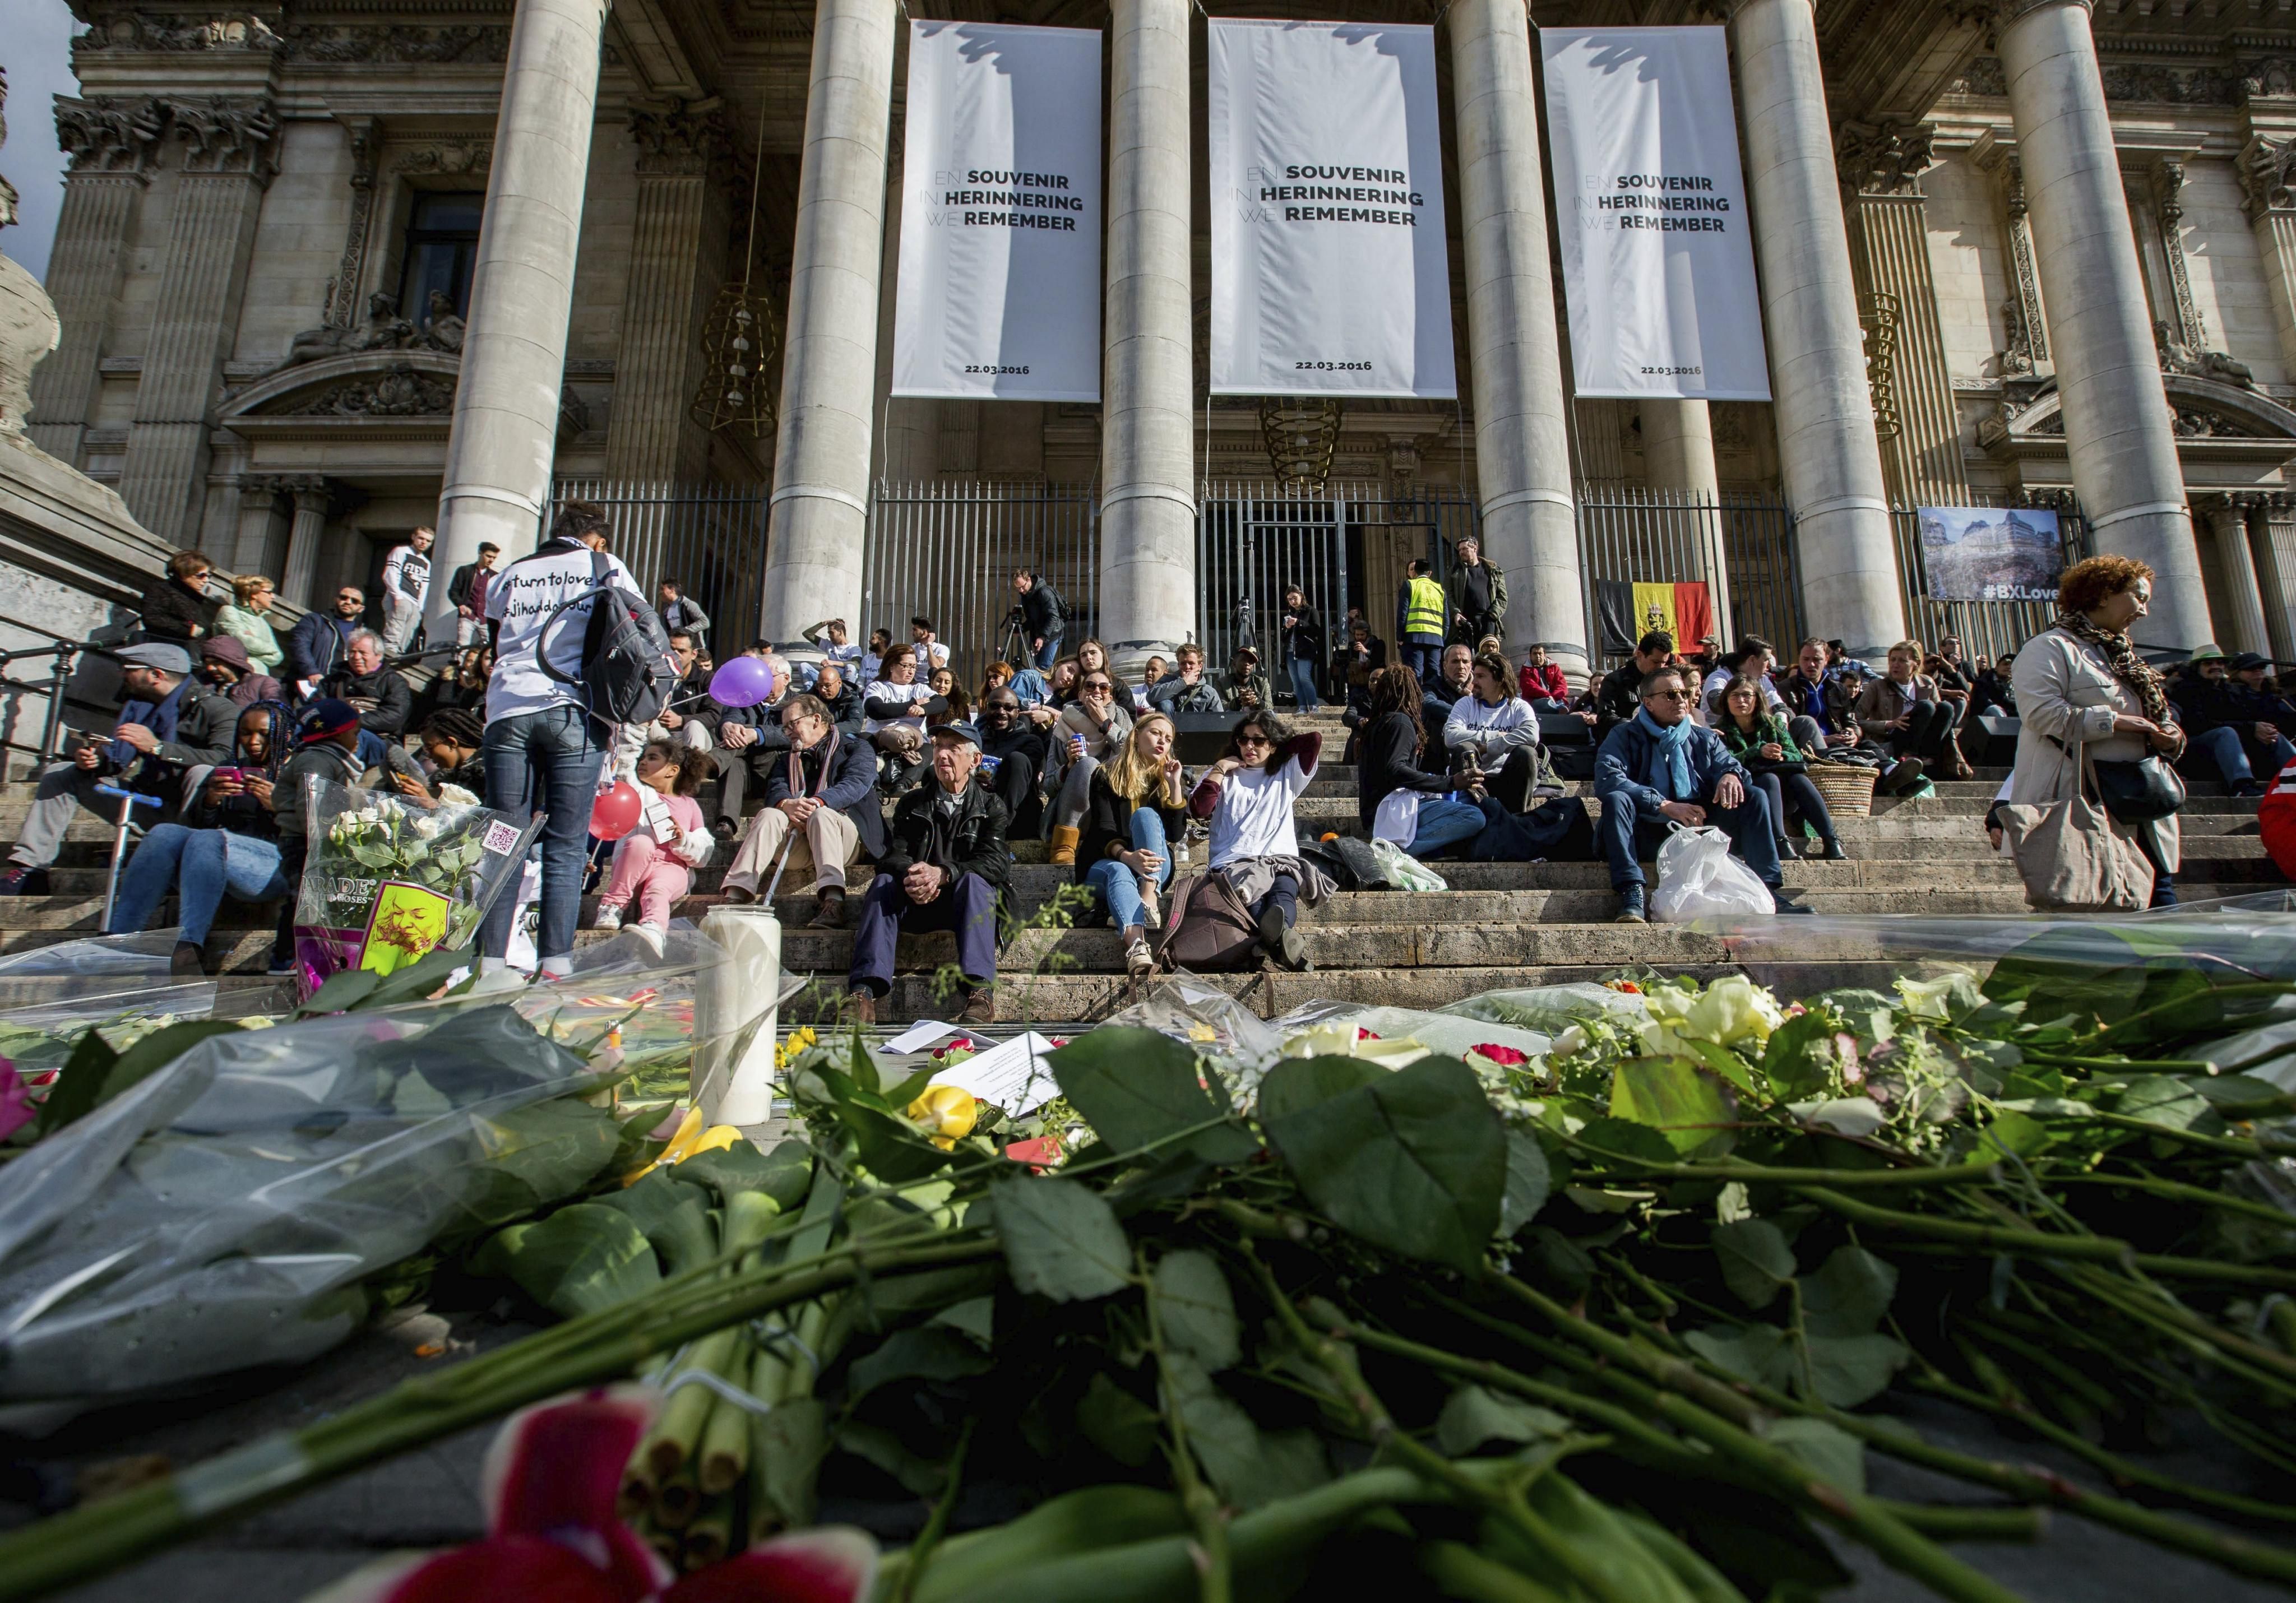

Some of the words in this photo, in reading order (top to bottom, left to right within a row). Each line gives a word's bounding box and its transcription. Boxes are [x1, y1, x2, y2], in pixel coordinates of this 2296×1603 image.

[935, 171, 960, 184] EN
[968, 170, 1069, 189] SOUVENIR
[1248, 166, 1277, 181] EN
[1286, 166, 1406, 184] SOUVENIR
[1586, 175, 1610, 189] EN
[1618, 175, 1713, 191] SOUVENIR
[920, 189, 938, 205] IN
[945, 191, 1082, 211] HERINNERING
[1232, 188, 1251, 202] IN
[1261, 186, 1424, 206] HERINNERING
[1574, 196, 1592, 210] IN
[1598, 195, 1730, 211] HERINNERING
[925, 212, 958, 226] WE
[964, 212, 1076, 231] REMEMBER
[1238, 208, 1276, 223] WE
[1285, 207, 1417, 226] REMEMBER
[1582, 216, 1614, 230] WE
[1620, 215, 1725, 233] REMEMBER
[965, 365, 1029, 374] 22.03.2016
[1295, 362, 1372, 371] 22.03.2016
[1641, 367, 1701, 376] 22.03.2016
